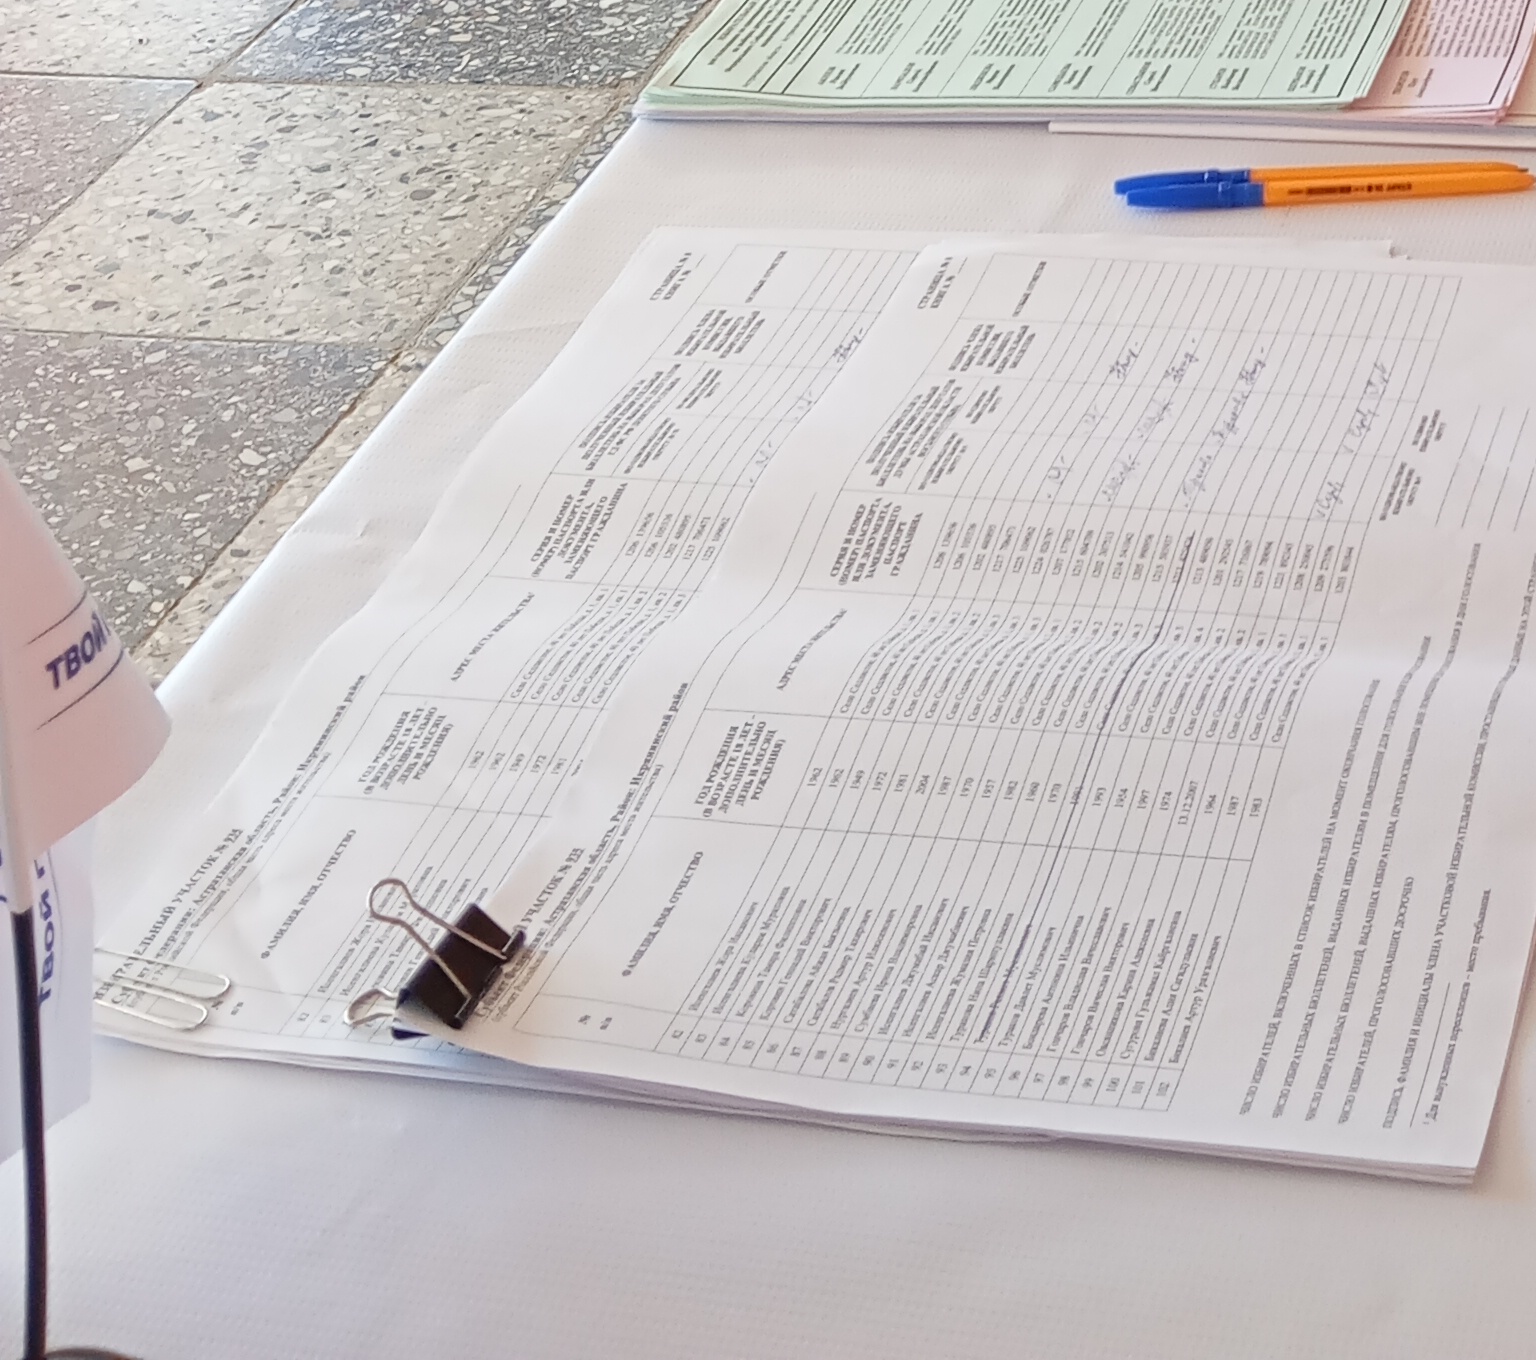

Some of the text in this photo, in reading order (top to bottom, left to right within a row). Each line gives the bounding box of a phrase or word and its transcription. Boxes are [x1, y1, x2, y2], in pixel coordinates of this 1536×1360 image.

[191, 844, 248, 906] Астраханская
[242, 804, 279, 845] область,
[341, 673, 367, 703] район
[694, 725, 738, 804] ГОД РОЖДЕНИЯ
[708, 754, 738, 806] ВОЗРАСТЕ
[738, 721, 753, 740] ЛЕТ
[718, 720, 767, 812] ДОПОЛНИТЕЛЬНО
[734, 777, 754, 805] ДЕНЬ
[752, 727, 777, 767] МЕСЯЦ
[750, 738, 785, 800] РОЖДЕНИЯ)
[870, 770, 888, 791] 1972
[544, 865, 592, 925] Астраханская
[585, 822, 618, 865] область,
[610, 787, 637, 822] Район:
[629, 714, 673, 787] Икрянинский
[667, 681, 689, 712] район
[1325, 821, 1337, 834] НА
[1329, 780, 1347, 819] МОМЕНТ
[1448, 792, 1474, 869] ИЗБИРАТЕЛЬНОЙ
[170, 852, 220, 905] УЧАСТОК
[316, 828, 357, 881] ОТЧЕСТВО
[668, 850, 704, 903] ОТЧЕСТВО
[1307, 836, 1332, 901] ИЗБИРАТЕЛЕЙ
[521, 874, 563, 924] УЧАСТОК
[1296, 903, 1315, 941] СПИСОК
[1433, 872, 1457, 936] УЧАСТКОВОЙ
[1283, 1011, 1315, 1086] ИЗБИРАТЕЛЬНЫХ
[1308, 945, 1334, 1009] БЮЛЛЕТЕНЕЙ,
[1327, 887, 1350, 942] ВЫДАННЫХ
[1342, 818, 1367, 885] ИЗБИРАТЕЛЯМ
[1294, 942, 1304, 950] В
[1425, 938, 1442, 970] ЧЛЕНА
[1273, 952, 1302, 1018] ВКЛЮЧЕННЫХ
[1316, 1014, 1348, 1089] ИЗБИРАТЕЛЬНЫХ
[1340, 947, 1366, 1012] БЮЛЛЕТЕНЕЙ,
[1358, 890, 1380, 945] ВЫДАННЫХ
[1348, 1028, 1376, 1092] ИЗБИРАТЕЛЕЙ,
[1368, 930, 1402, 1027] ПРОГОЛОСОВАВШИХ
[1394, 876, 1415, 928] ДОСРОЧНО
[1411, 972, 1434, 1026] ИНИЦИАЛЫ
[1396, 1036, 1417, 1083] ФАМИЛИЯ
